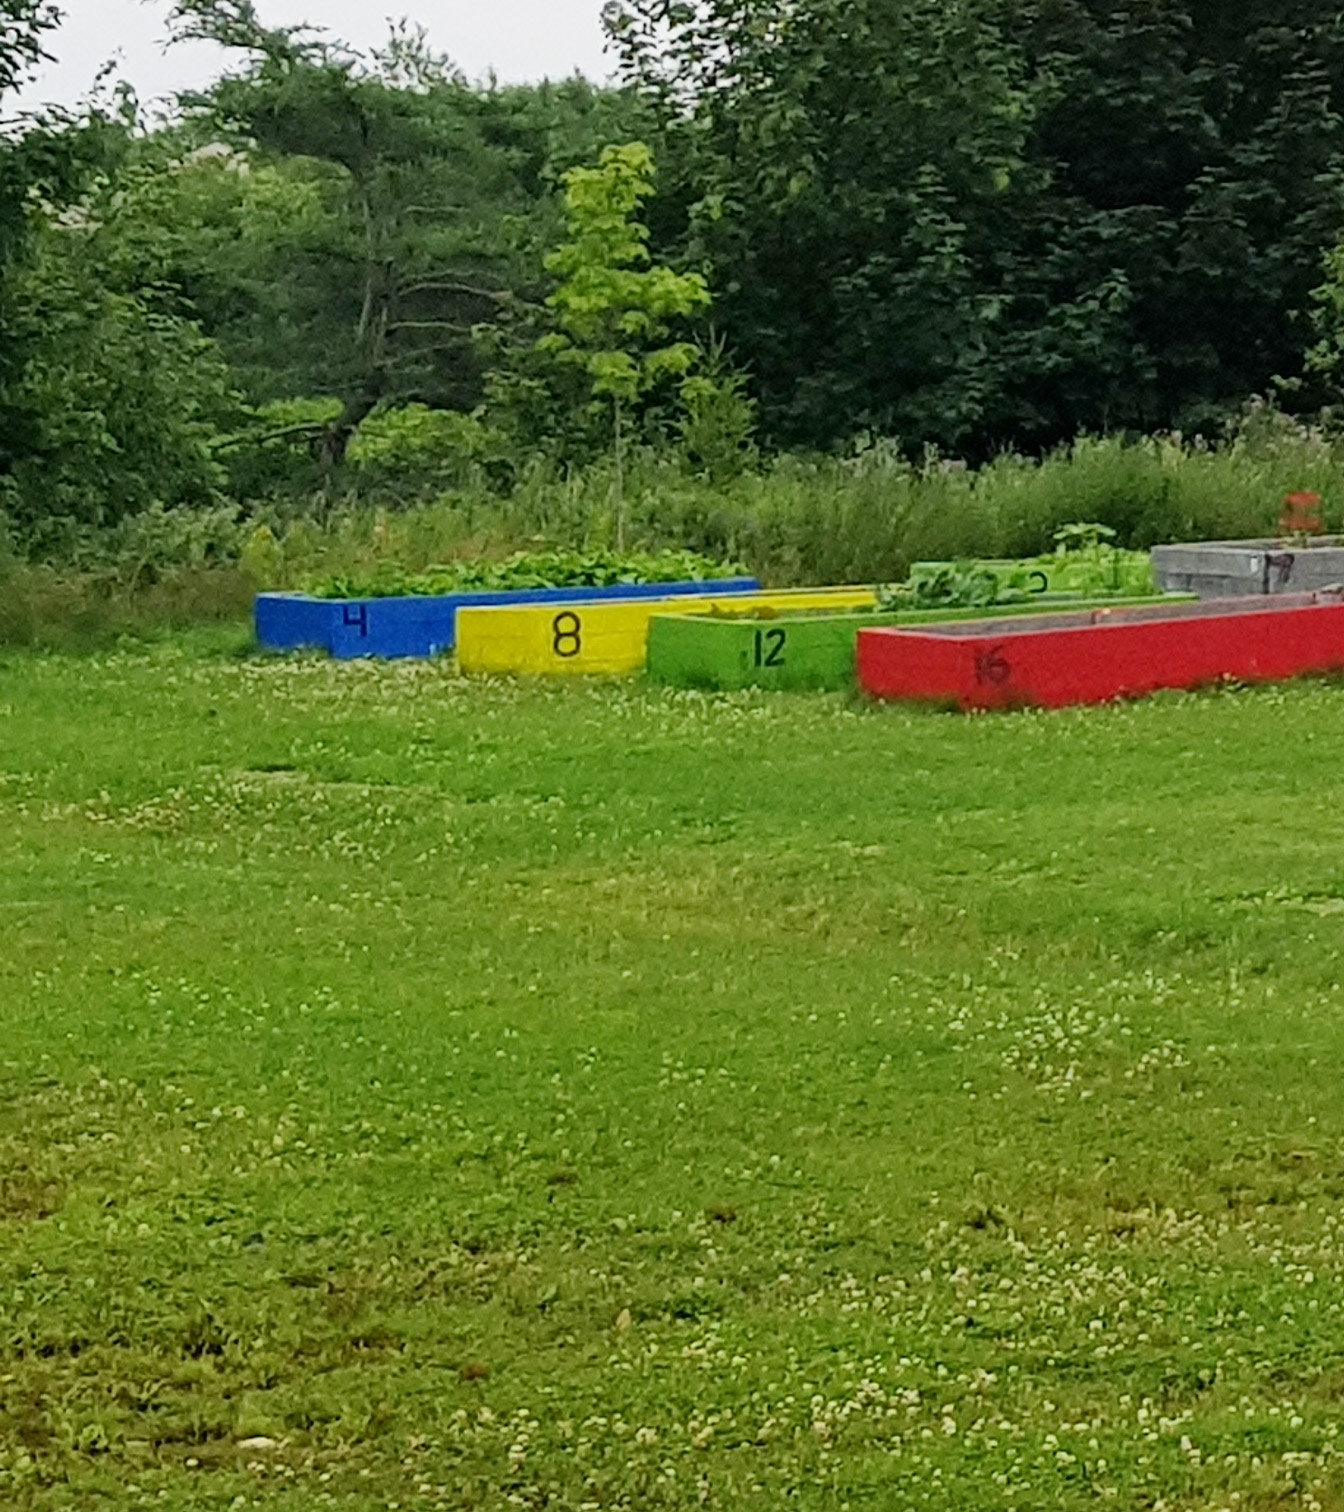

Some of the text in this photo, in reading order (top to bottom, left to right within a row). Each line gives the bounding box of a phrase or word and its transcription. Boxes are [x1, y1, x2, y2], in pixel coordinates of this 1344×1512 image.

[343, 605, 368, 637] 4
[553, 611, 581, 658] 8
[754, 628, 786, 667] 12
[974, 644, 1011, 685] 16
